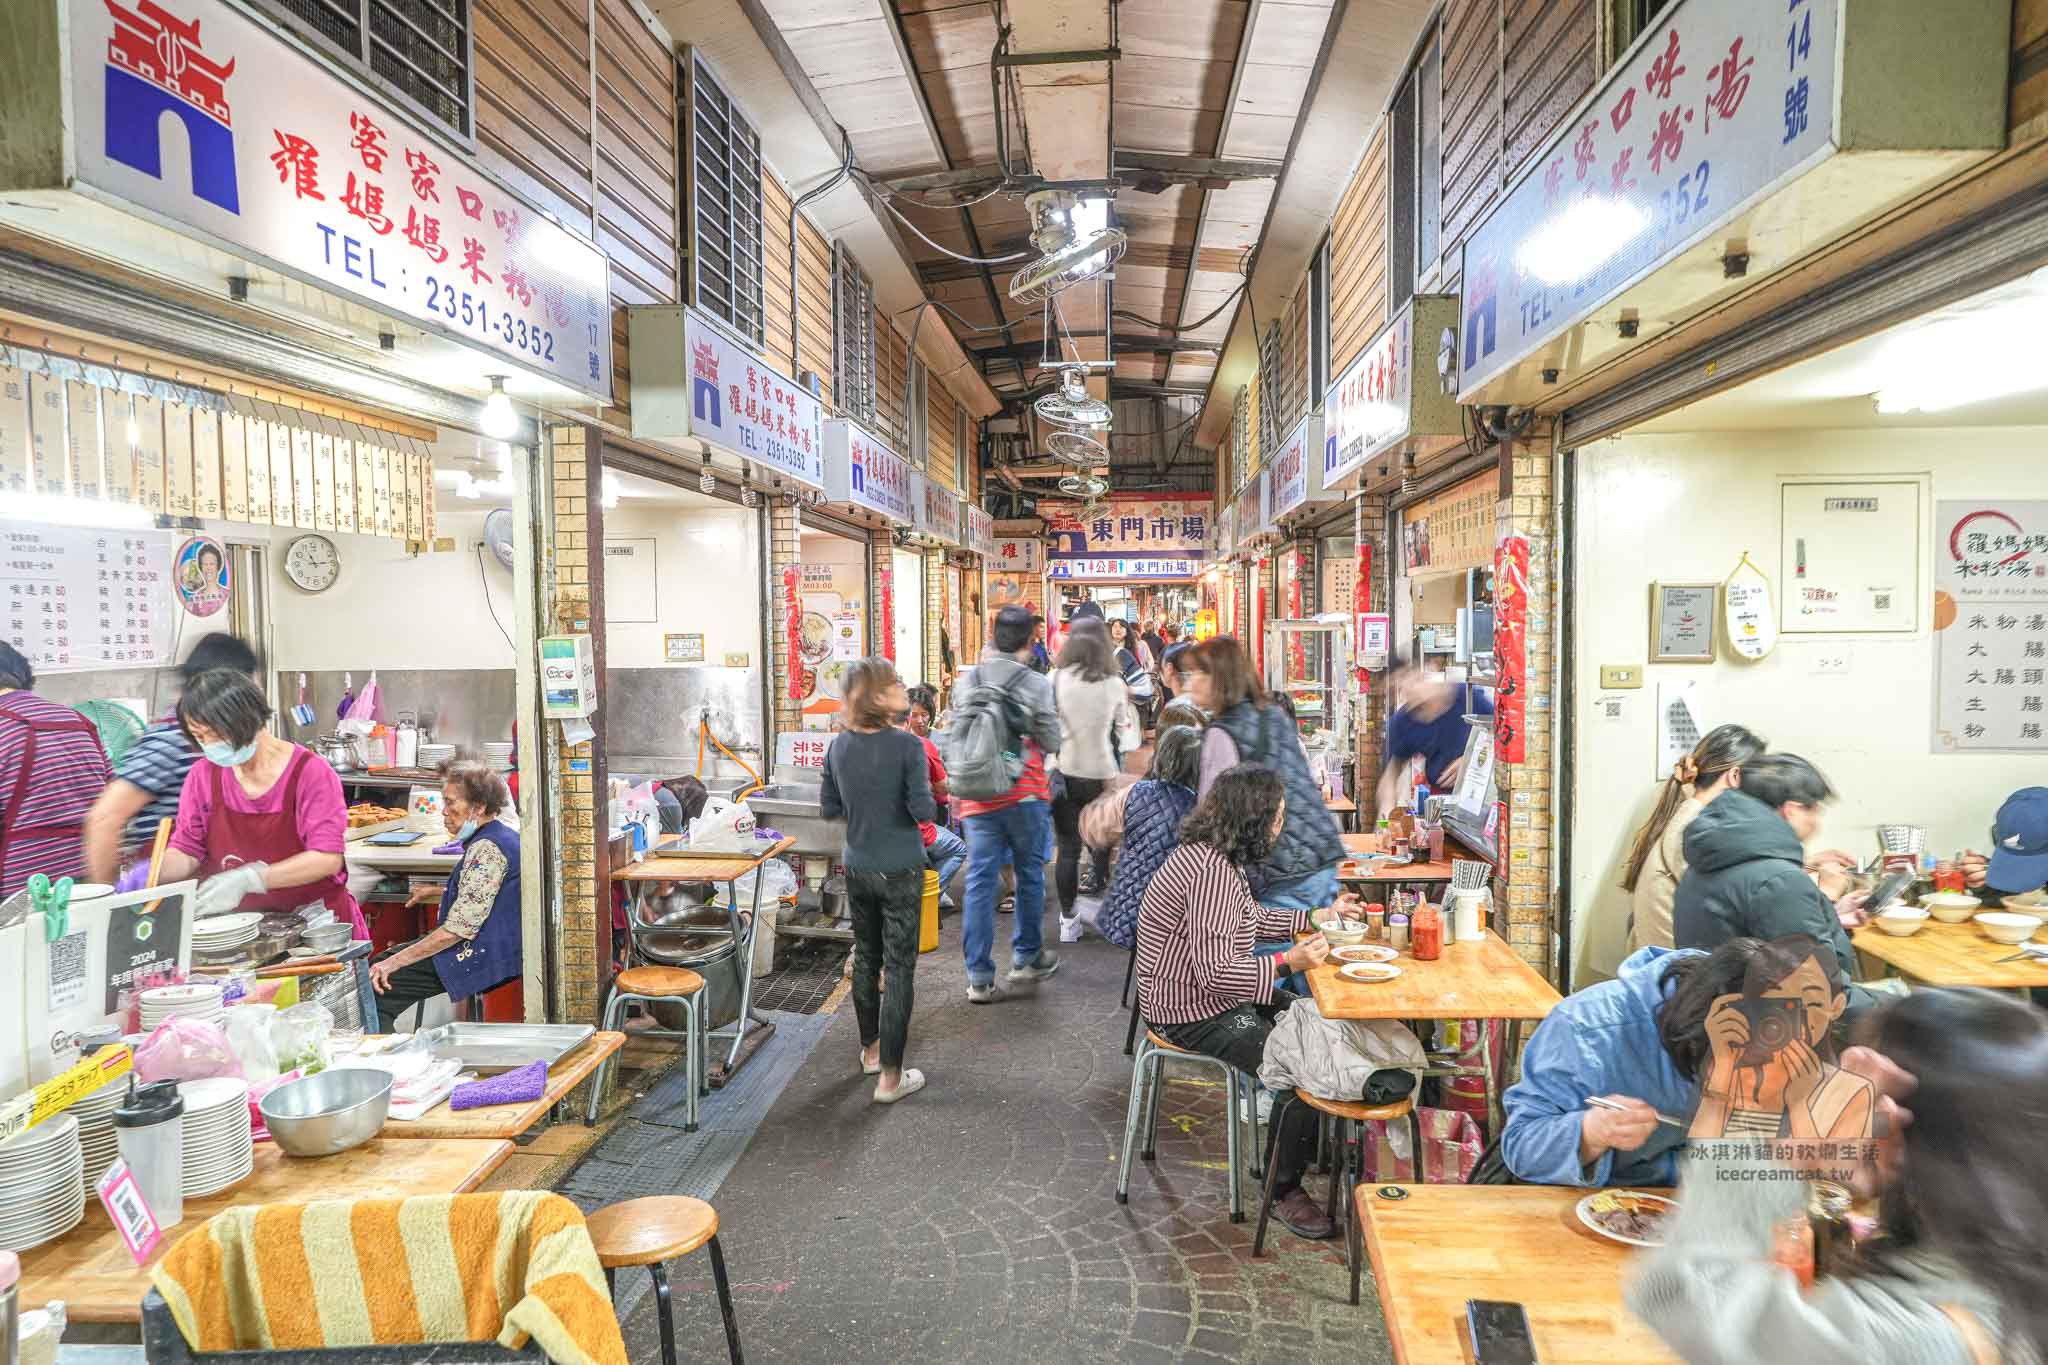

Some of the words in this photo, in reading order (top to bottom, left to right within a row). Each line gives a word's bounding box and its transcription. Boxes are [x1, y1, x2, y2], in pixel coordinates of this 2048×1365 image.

[351, 110, 520, 244] 客家口味
[270, 128, 571, 328] 羅媽媽米粉湯
[425, 275, 555, 363] 2351-3352
[747, 363, 797, 417] 客家口味
[728, 383, 812, 453] 羅媽媽米粉湯
[766, 437, 806, 472] 2351-3352
[1091, 516, 1204, 541] 東門市場
[1134, 560, 1187, 573] 東門市場
[1967, 614, 2048, 631] 米粉湯
[1966, 668, 2046, 685] 大腸頭
[130, 951, 157, 967] 2024
